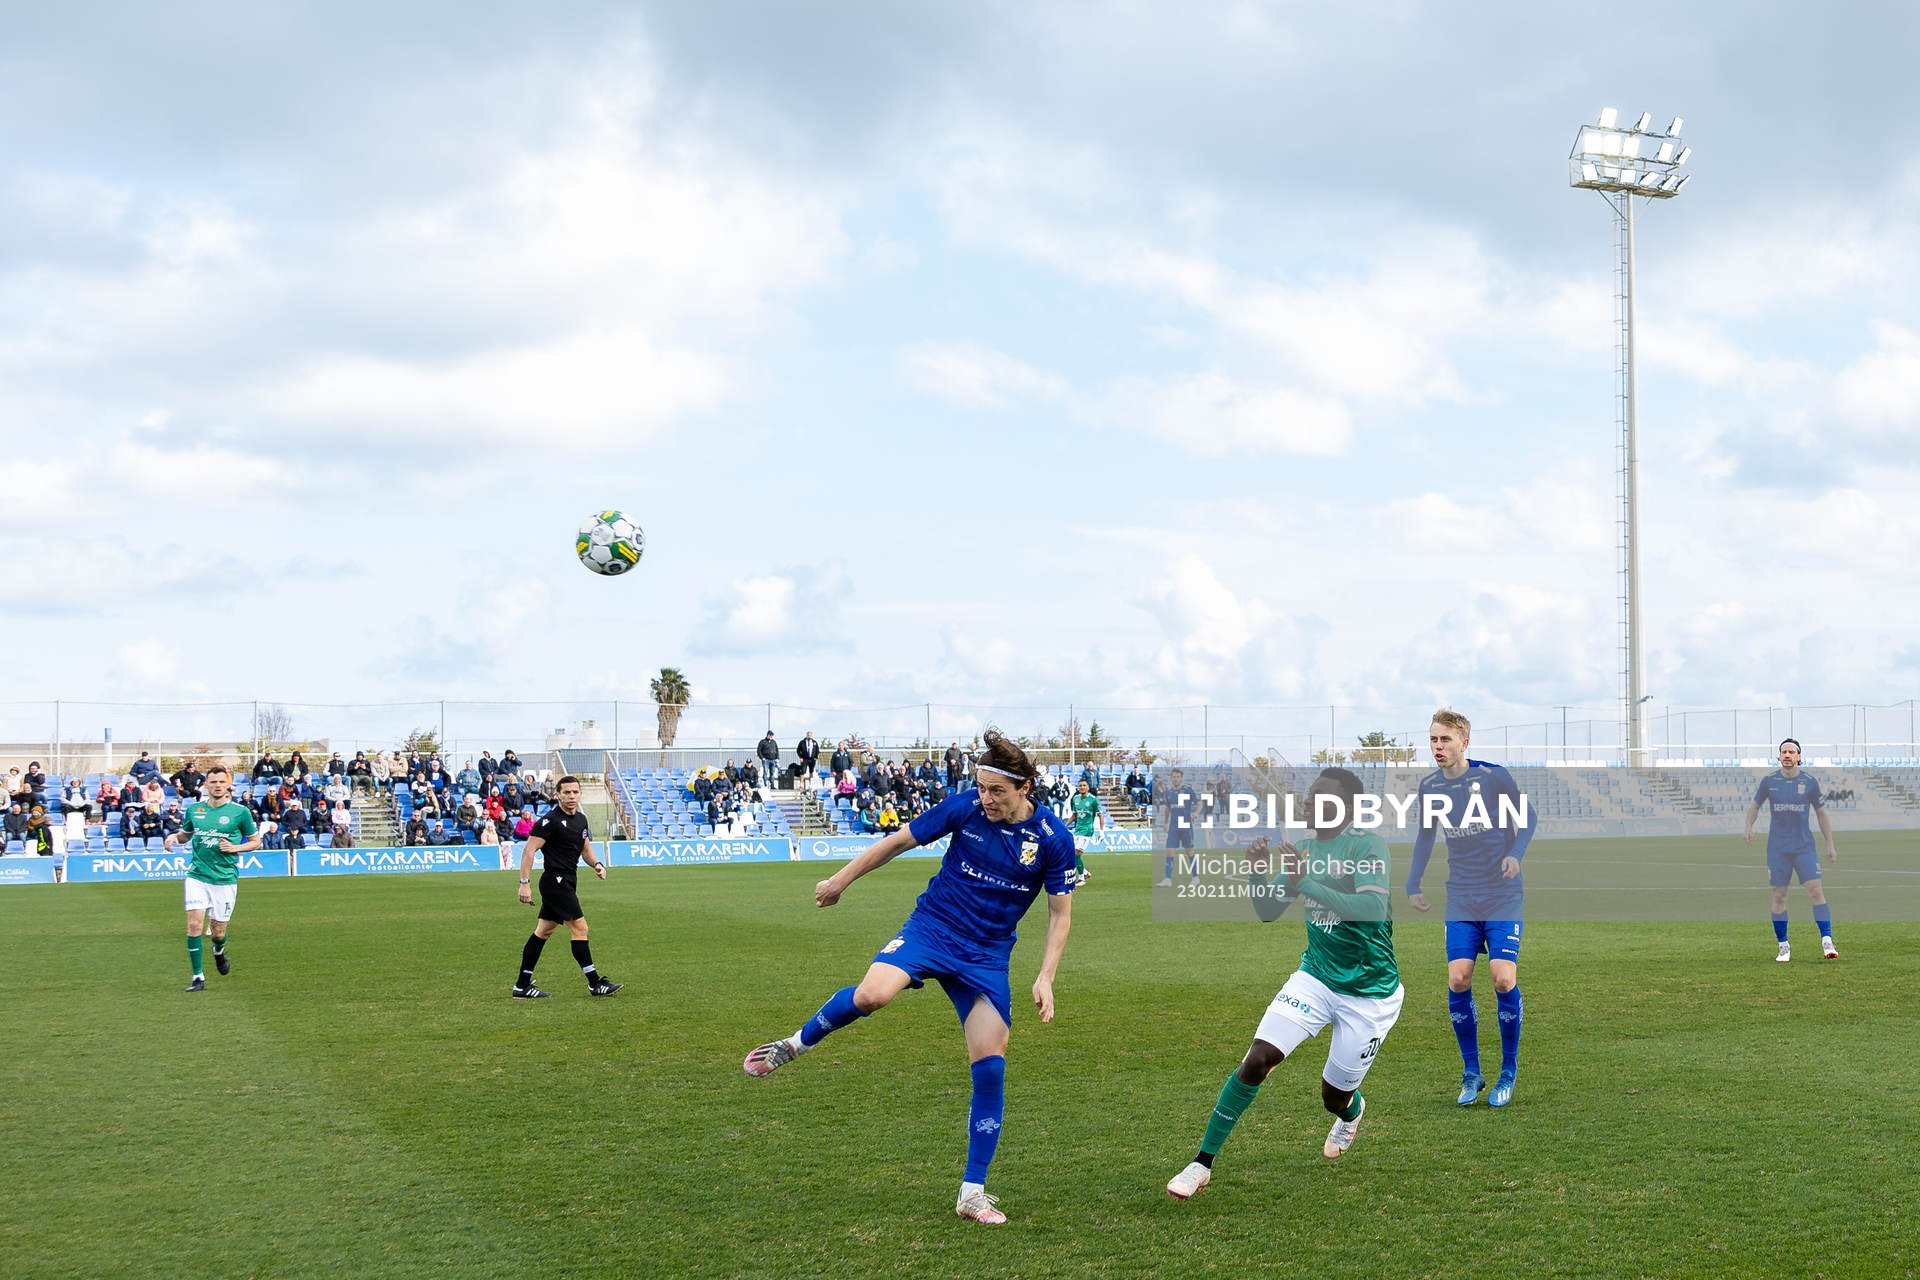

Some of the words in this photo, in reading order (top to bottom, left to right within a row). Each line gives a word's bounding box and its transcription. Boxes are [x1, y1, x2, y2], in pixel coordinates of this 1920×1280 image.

[1444, 822, 1489, 838] ERNEK
[630, 842, 769, 858] PINATARARENA
[320, 850, 478, 867] PINATARARENA
[1311, 910, 1341, 934] Kaffe
